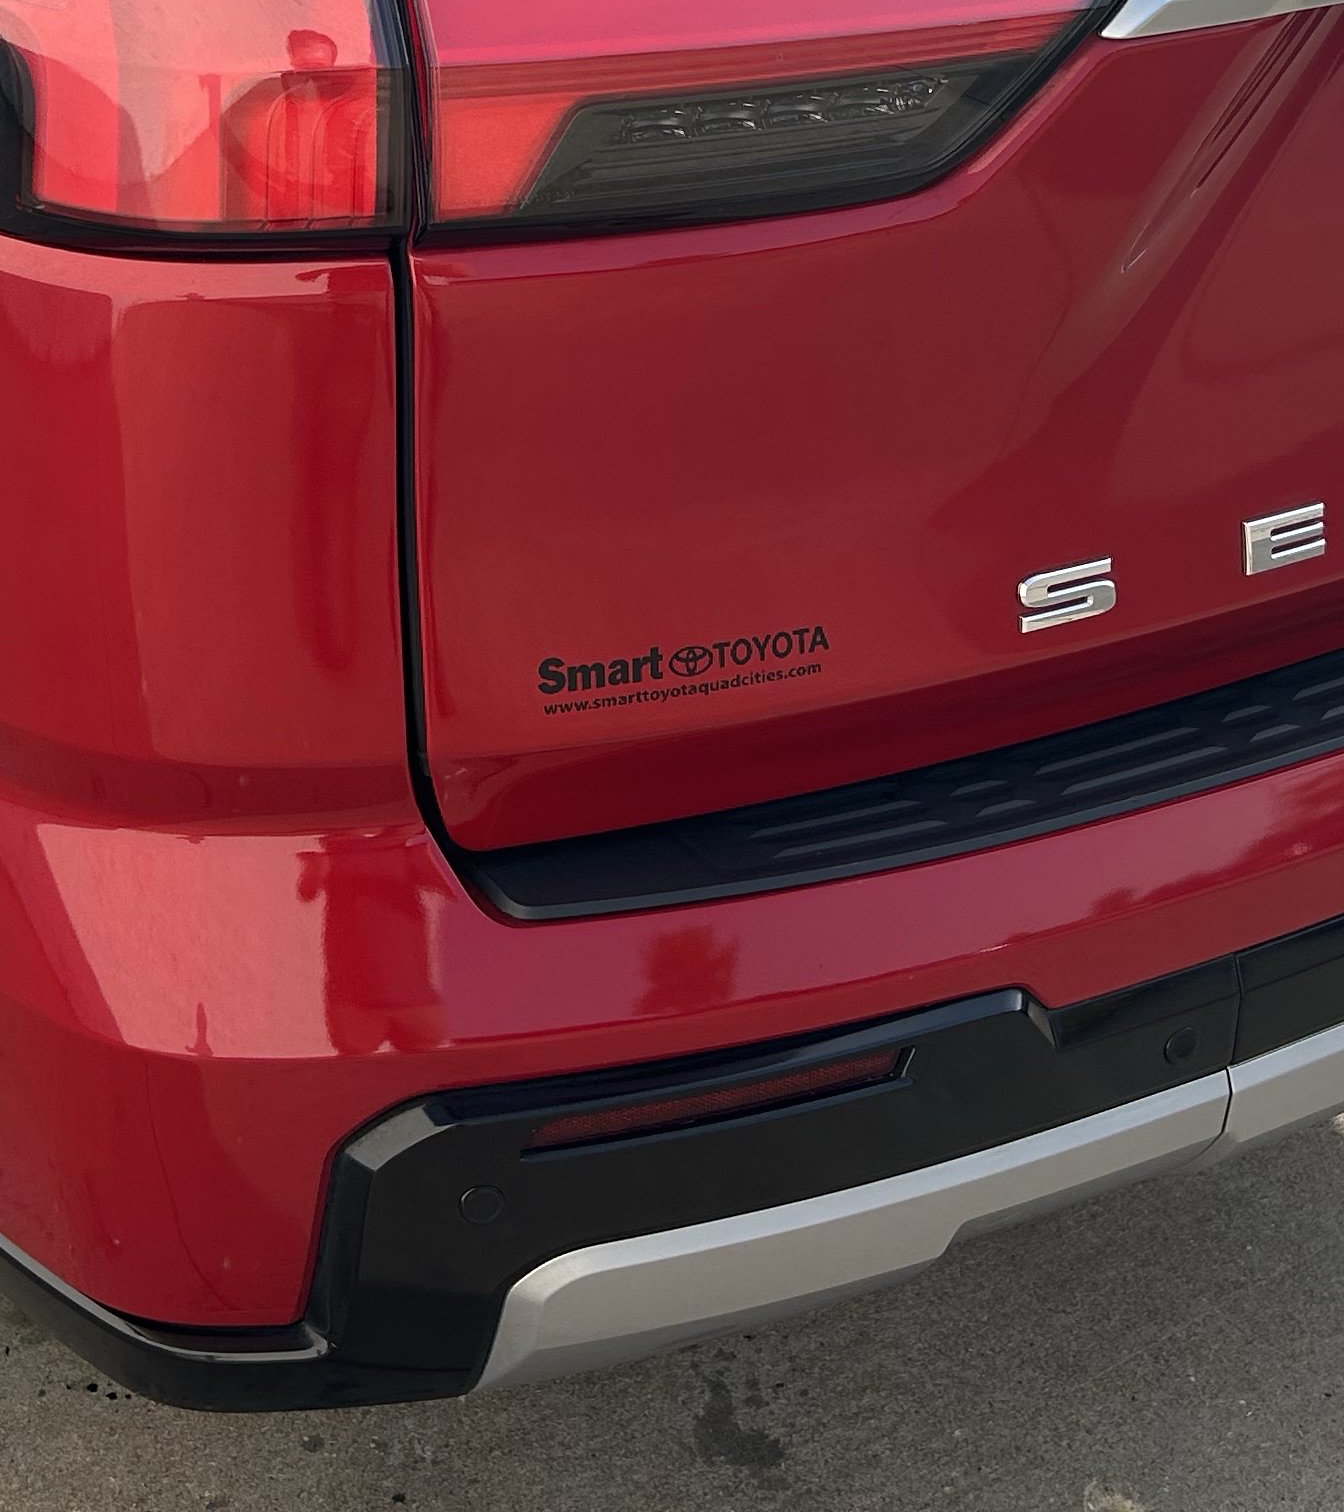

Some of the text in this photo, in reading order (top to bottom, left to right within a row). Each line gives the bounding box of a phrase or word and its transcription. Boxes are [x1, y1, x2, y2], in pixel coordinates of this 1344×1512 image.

[537, 626, 830, 695] Smart TOYOTA
[543, 662, 823, 716] www.smarttoyotaquadcities.com
